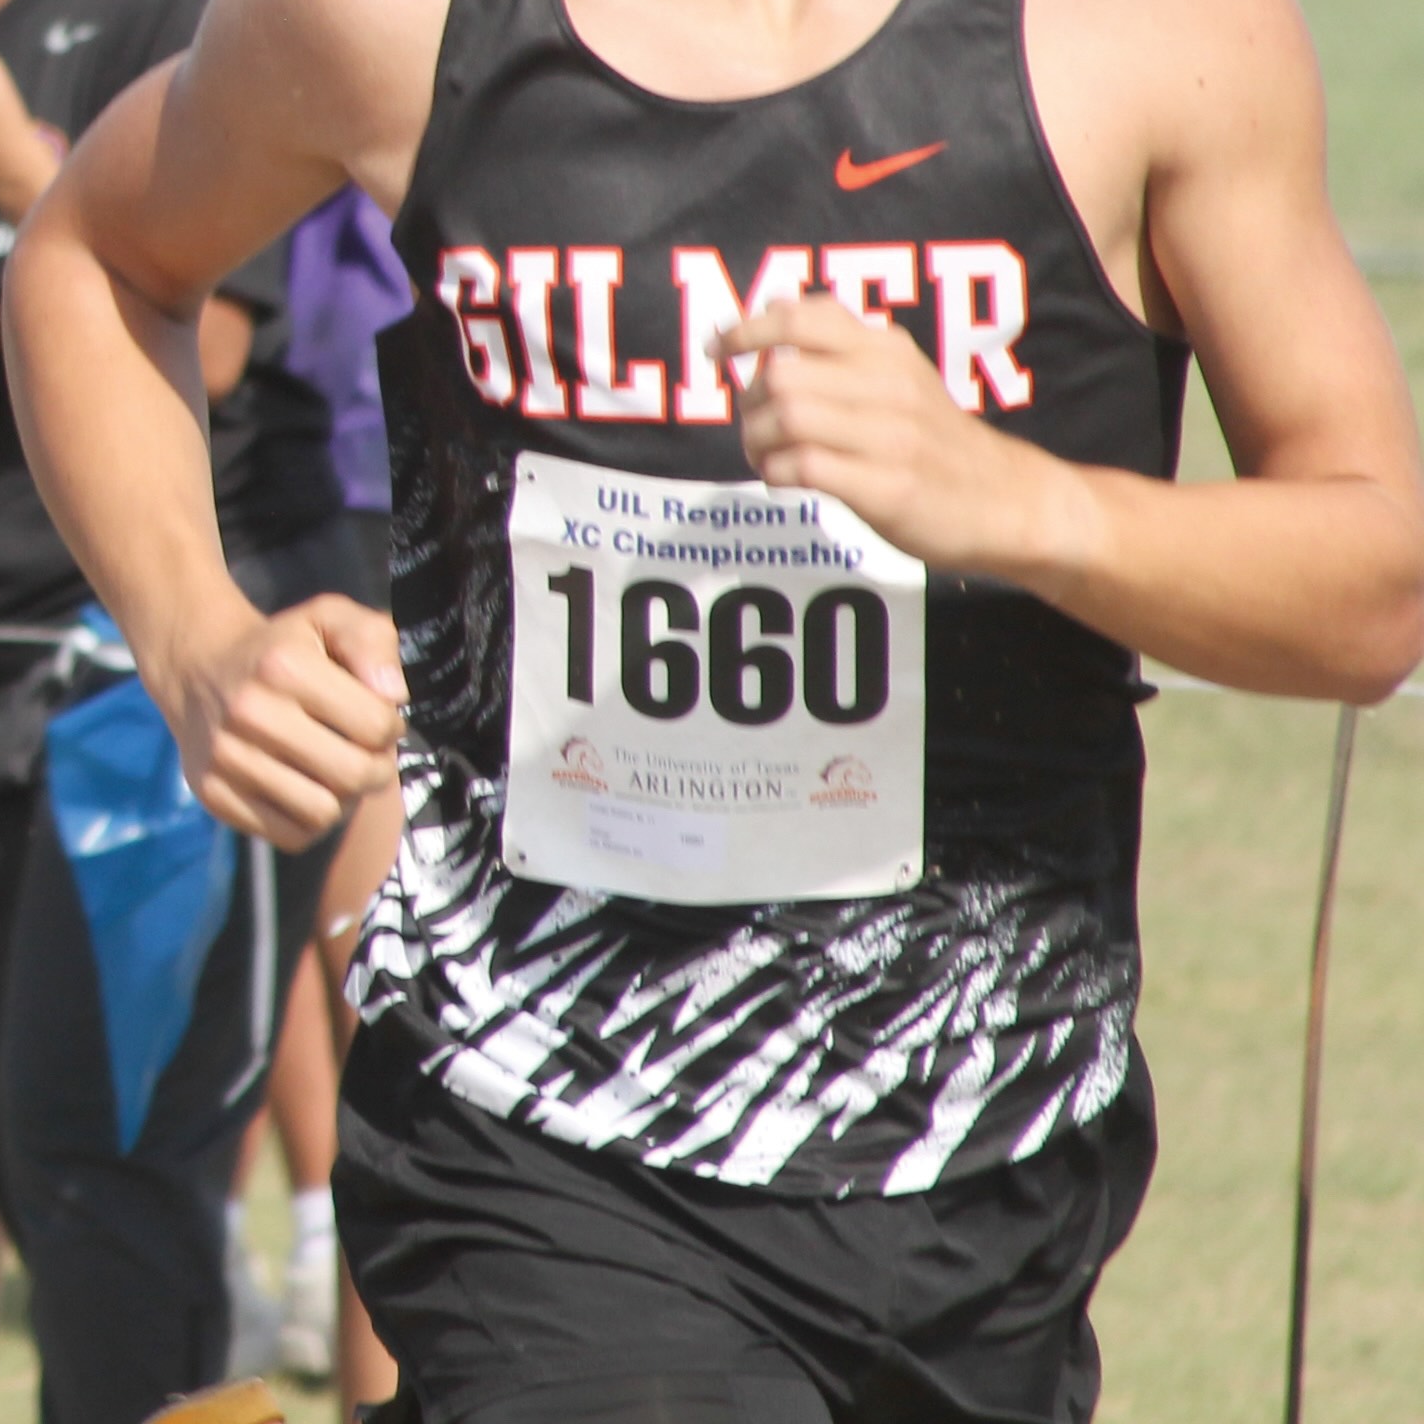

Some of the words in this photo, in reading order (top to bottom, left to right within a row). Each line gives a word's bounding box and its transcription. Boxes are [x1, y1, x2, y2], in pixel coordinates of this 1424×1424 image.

[598, 486, 649, 518] UIL
[663, 497, 786, 531] Region
[800, 499, 820, 525] II
[563, 517, 601, 548] XC
[613, 530, 865, 571] Championship
[547, 562, 890, 727] 1660
[614, 746, 639, 766] The
[647, 752, 722, 777] University
[629, 771, 784, 801] ARLINGTON
